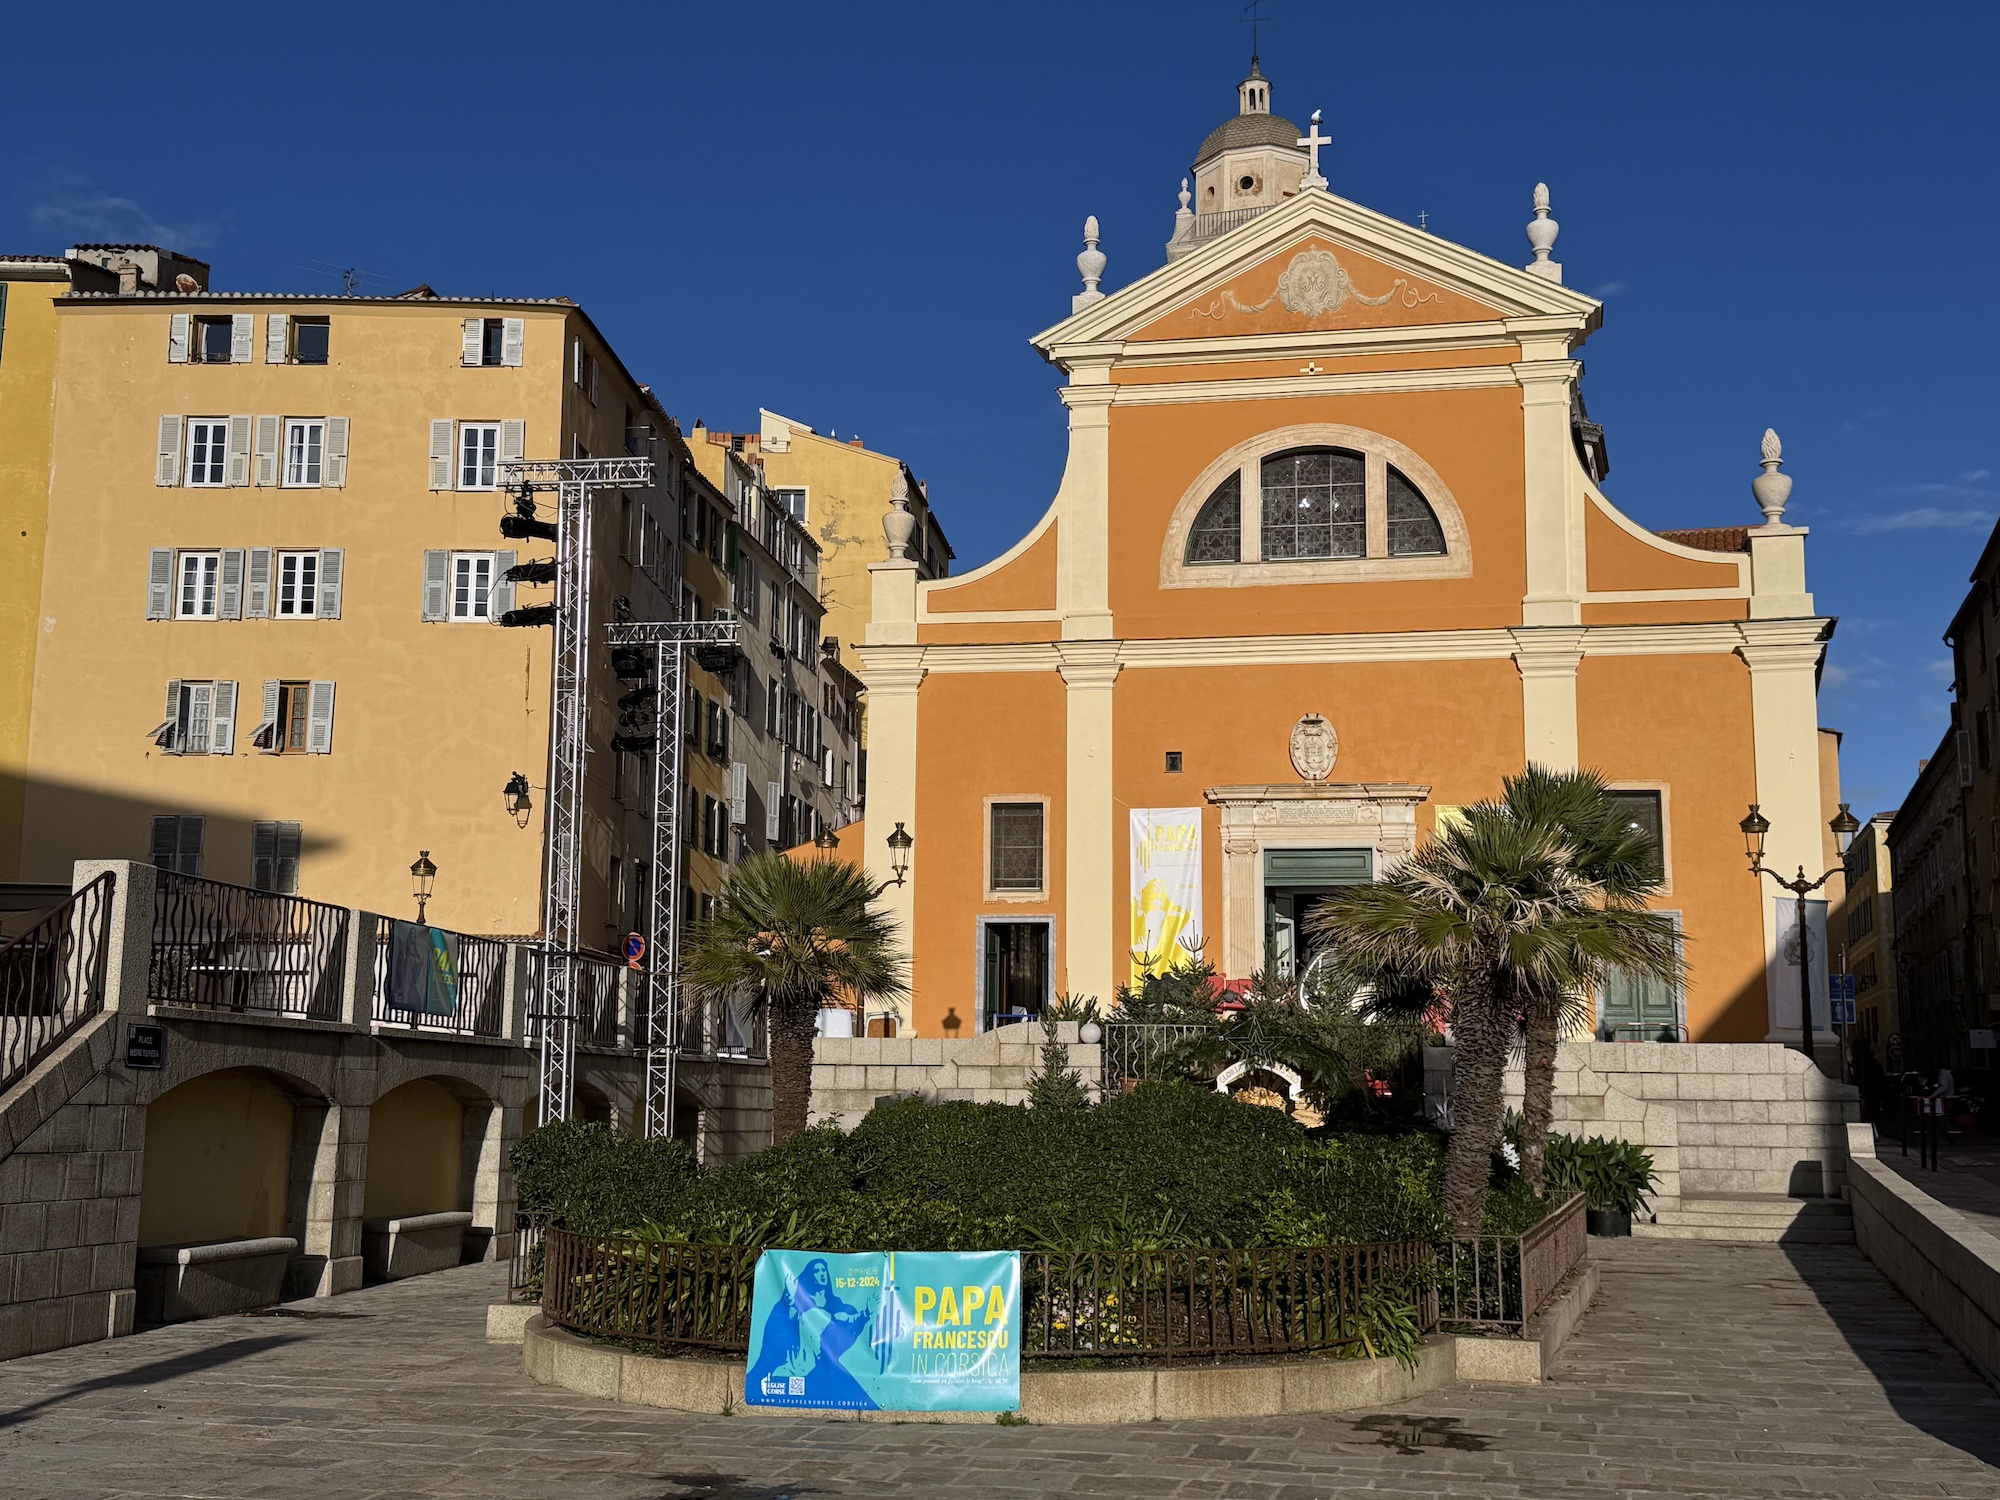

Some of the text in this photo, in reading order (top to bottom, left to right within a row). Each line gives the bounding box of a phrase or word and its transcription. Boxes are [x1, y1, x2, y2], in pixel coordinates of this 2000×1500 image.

[1155, 824, 1198, 842] PAPA
[138, 1036, 153, 1044] PLACE
[914, 1285, 1008, 1326] PAPA
[913, 1330, 1009, 1349] FRANCESCU
[911, 1352, 1009, 1378] IN CORSICA
